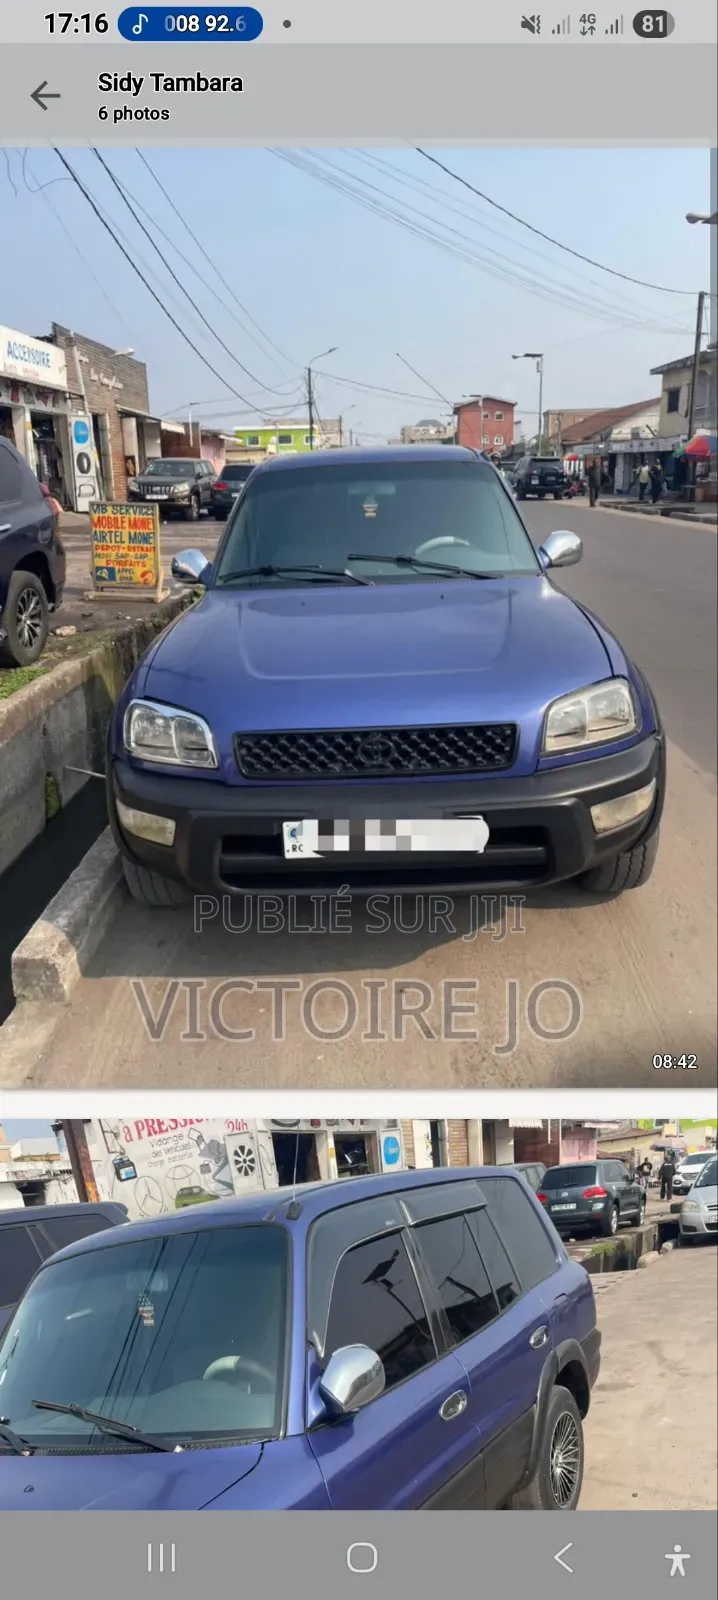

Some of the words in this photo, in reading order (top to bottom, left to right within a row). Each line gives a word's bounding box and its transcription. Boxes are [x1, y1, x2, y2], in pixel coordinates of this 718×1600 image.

[7, 340, 51, 369] ACCESSOIRE
[92, 515, 126, 530] MOBILE
[93, 529, 125, 544] AIRTEL
[128, 531, 155, 545] MONE
[149, 1133, 184, 1148] Vidange
